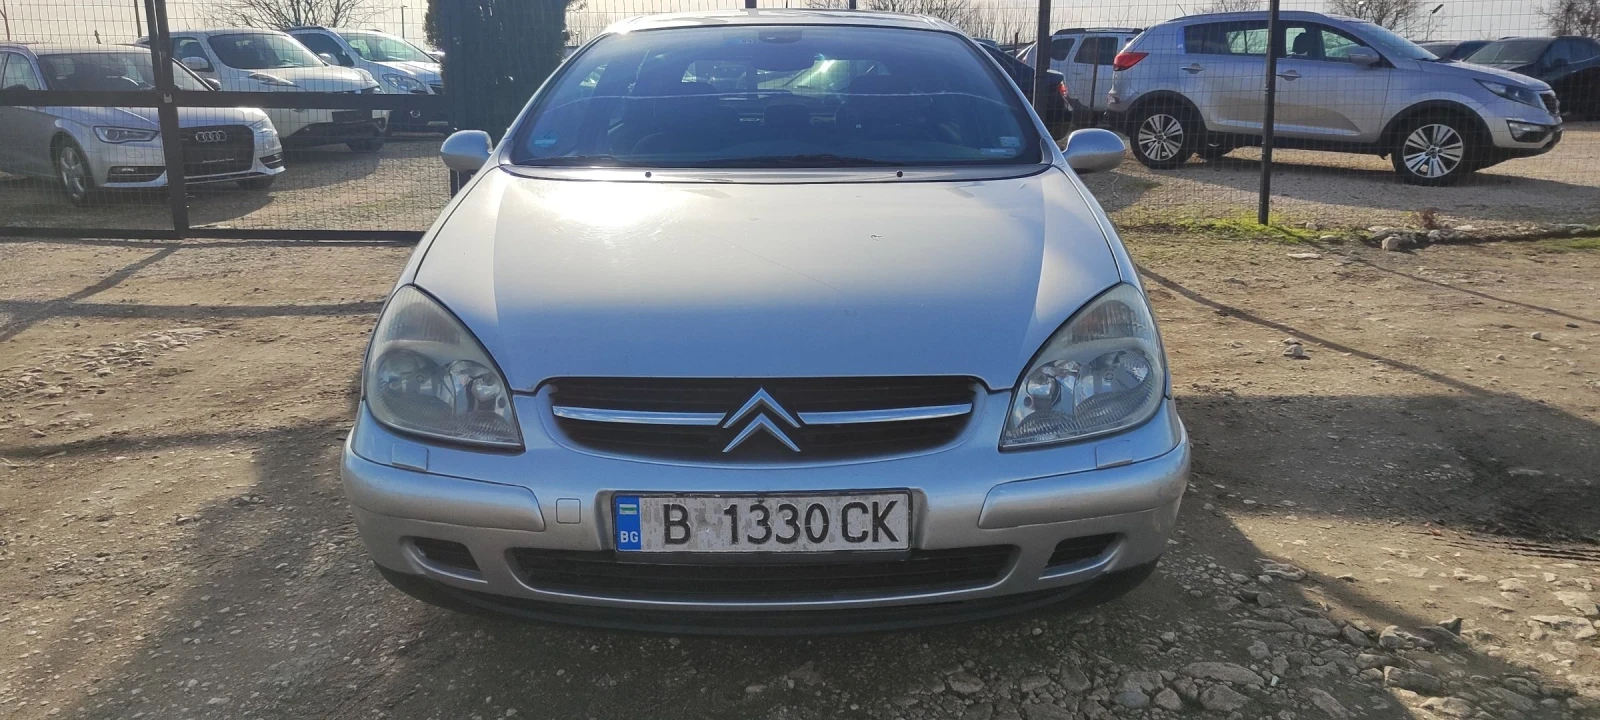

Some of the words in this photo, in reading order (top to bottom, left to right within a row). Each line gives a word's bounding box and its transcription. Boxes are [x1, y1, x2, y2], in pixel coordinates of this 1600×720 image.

[663, 503, 691, 545] B
[723, 502, 830, 545] 1330
[841, 500, 899, 543] CK
[620, 531, 639, 543] BG
